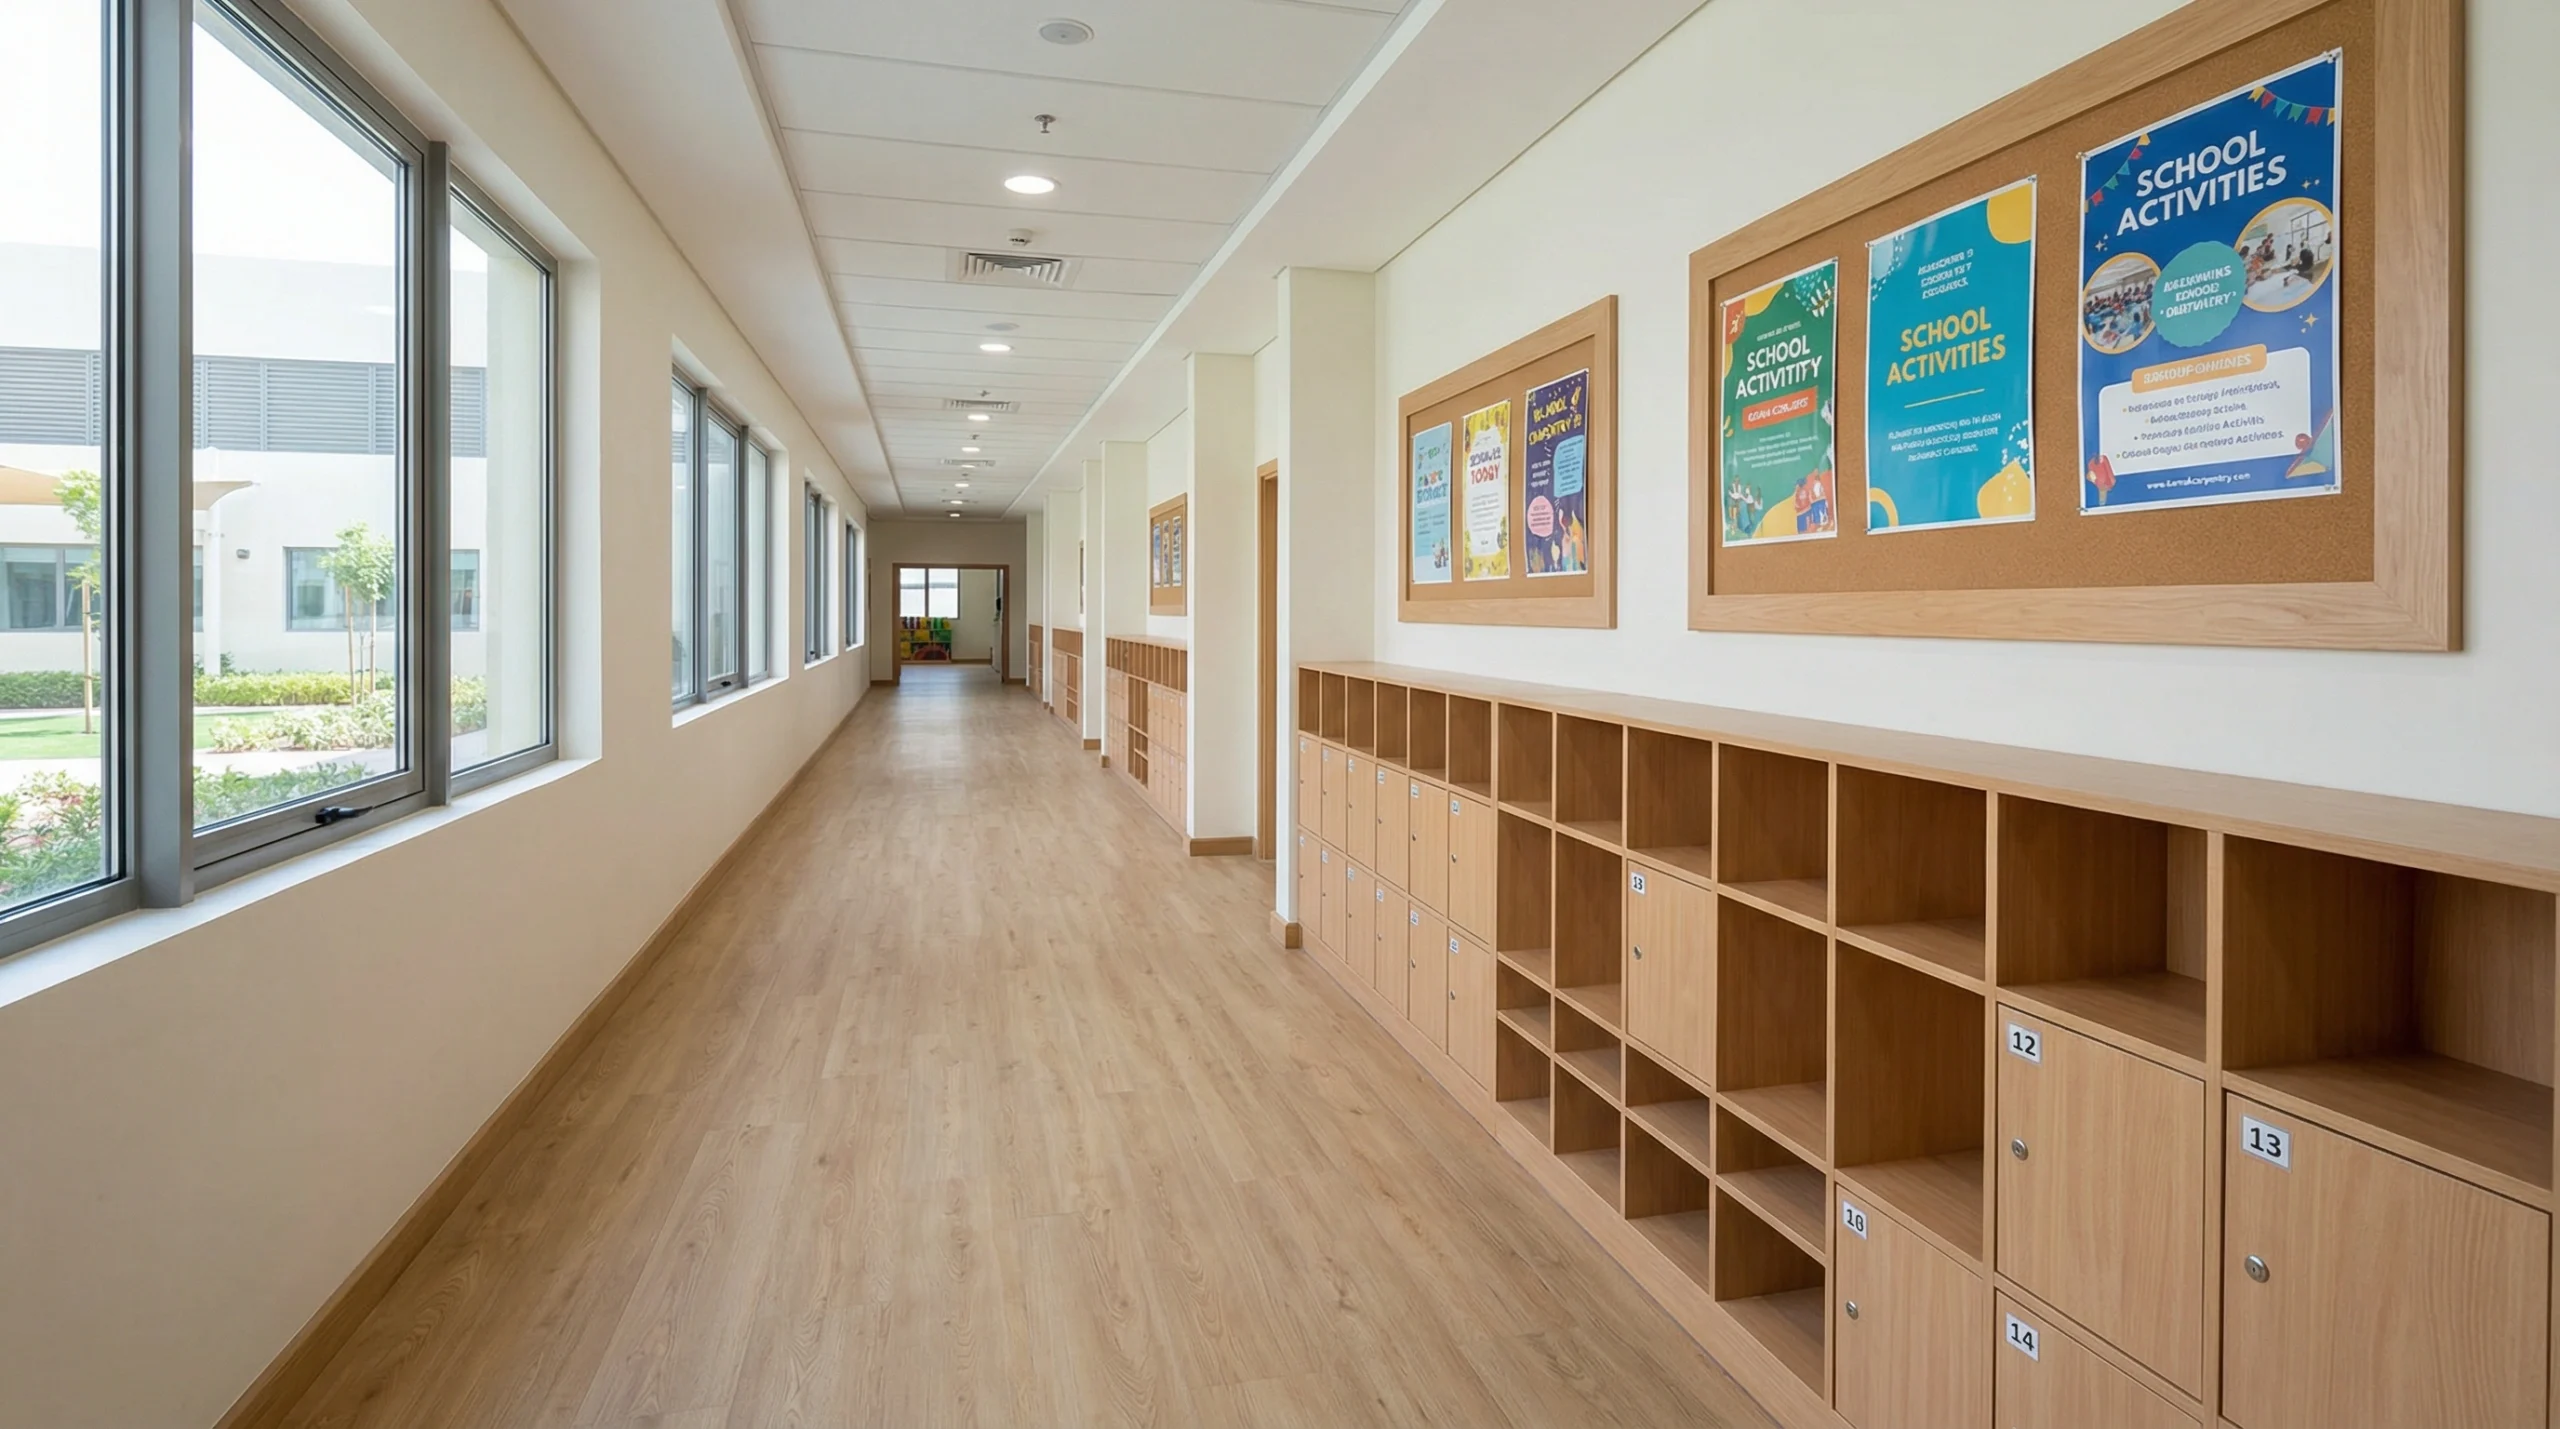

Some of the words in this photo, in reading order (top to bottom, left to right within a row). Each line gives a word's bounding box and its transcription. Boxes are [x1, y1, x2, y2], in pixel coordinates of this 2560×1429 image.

[2136, 129, 2266, 197] SCHOOL
[2116, 154, 2288, 237] ACTIVITIES
[1901, 306, 1991, 352] SCHOOL
[1747, 335, 1811, 372] SCHOOL
[1886, 334, 2006, 386] ACTIVITIES
[2013, 1031, 2036, 1057] 12
[2250, 1127, 2282, 1158] 13
[2011, 1322, 2035, 1352] 14
